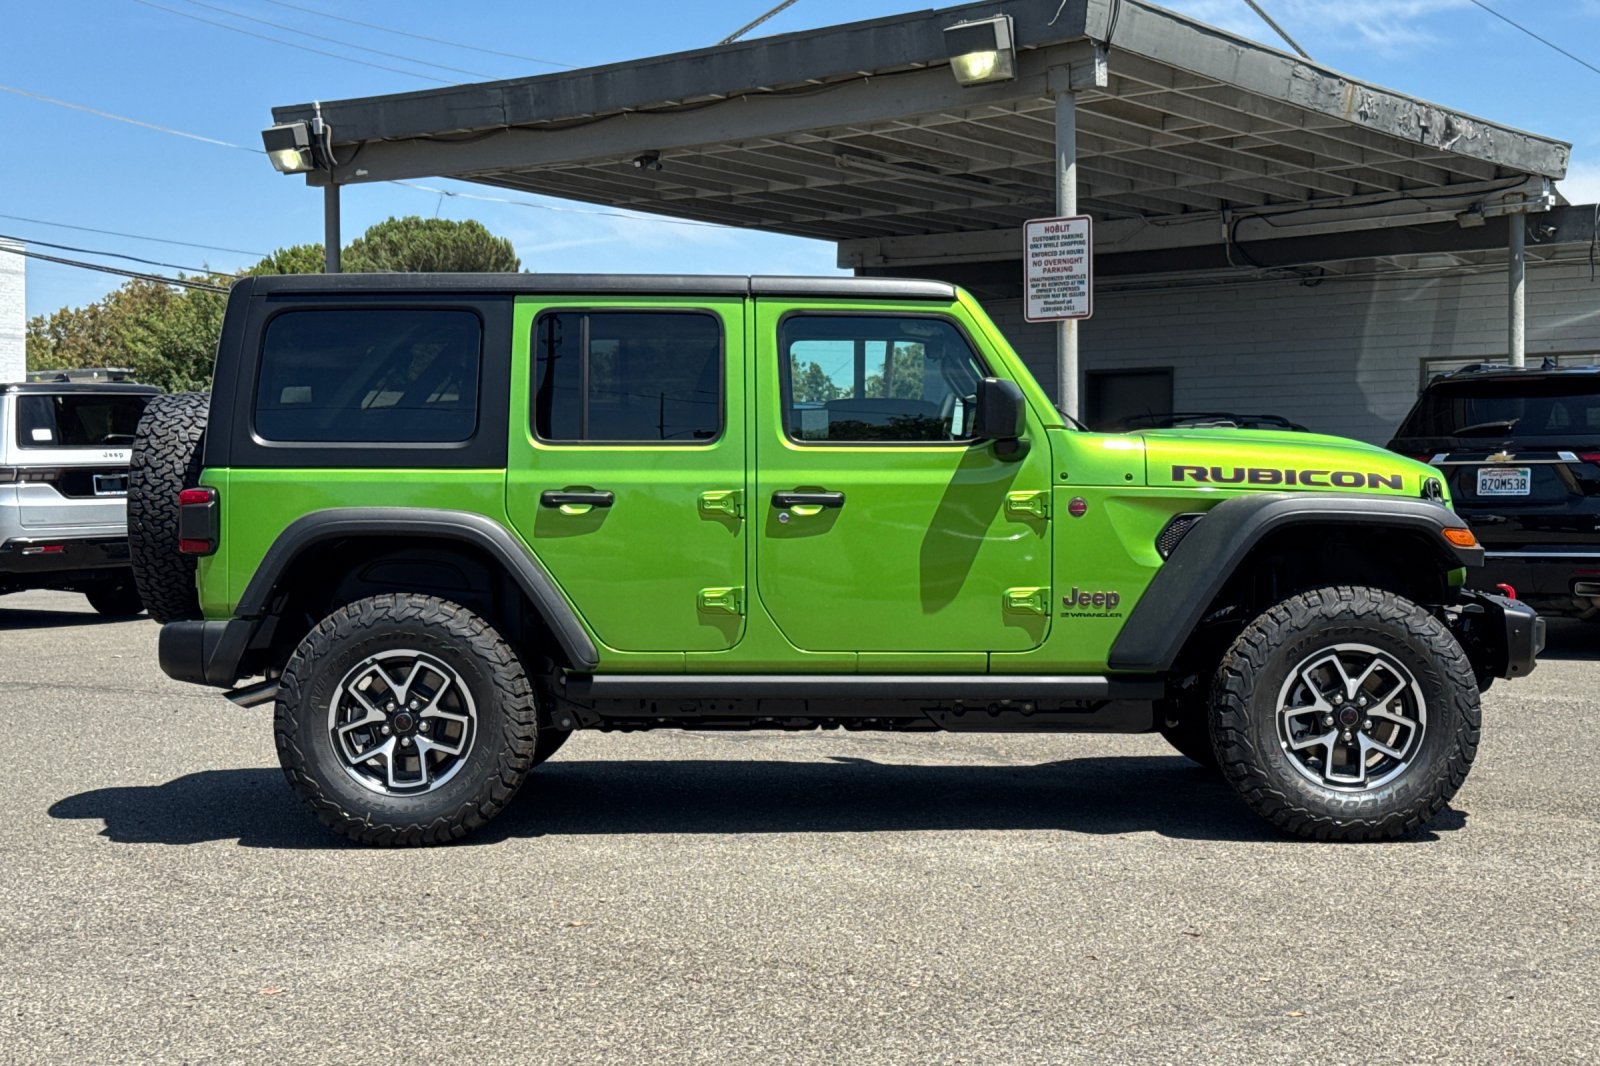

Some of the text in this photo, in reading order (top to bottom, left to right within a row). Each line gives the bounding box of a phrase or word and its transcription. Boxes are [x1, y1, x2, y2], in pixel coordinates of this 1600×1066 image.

[1044, 224, 1070, 234] HOBLIT
[1044, 256, 1083, 266] OVERNIGHT
[1042, 266, 1073, 274] PARKING
[1171, 465, 1404, 490] RUBICON
[1062, 586, 1120, 610] Jeep
